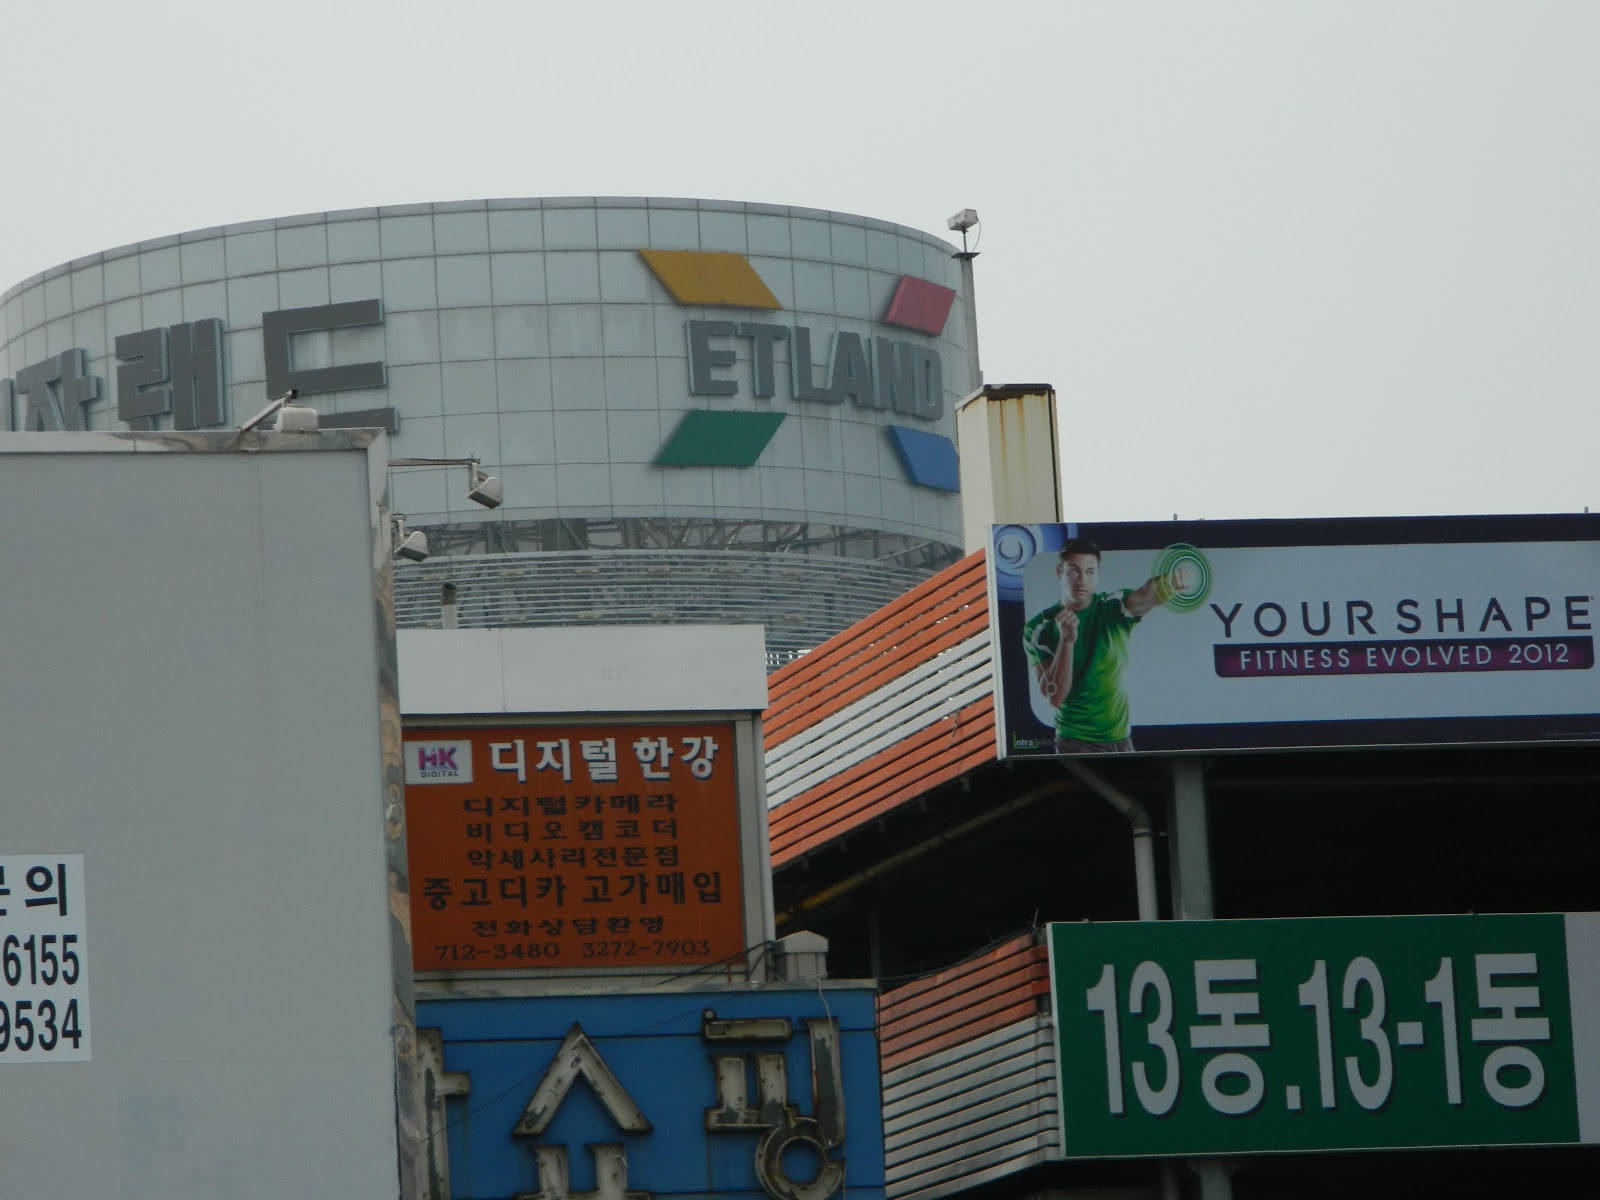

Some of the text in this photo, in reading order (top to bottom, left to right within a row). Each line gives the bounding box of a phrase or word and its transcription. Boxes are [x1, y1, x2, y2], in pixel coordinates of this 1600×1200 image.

[0, 297, 397, 432] 자랜드
[686, 319, 945, 420] ETLAND
[1240, 643, 1570, 671] FITNESS EVOLVED 2012
[421, 770, 459, 778] DIGITAL
[490, 736, 719, 782] 디지털 한강
[0, 864, 67, 917] 의
[423, 871, 722, 911] 중고디카 고가매입
[434, 940, 710, 961] 712-3480 3272-7903
